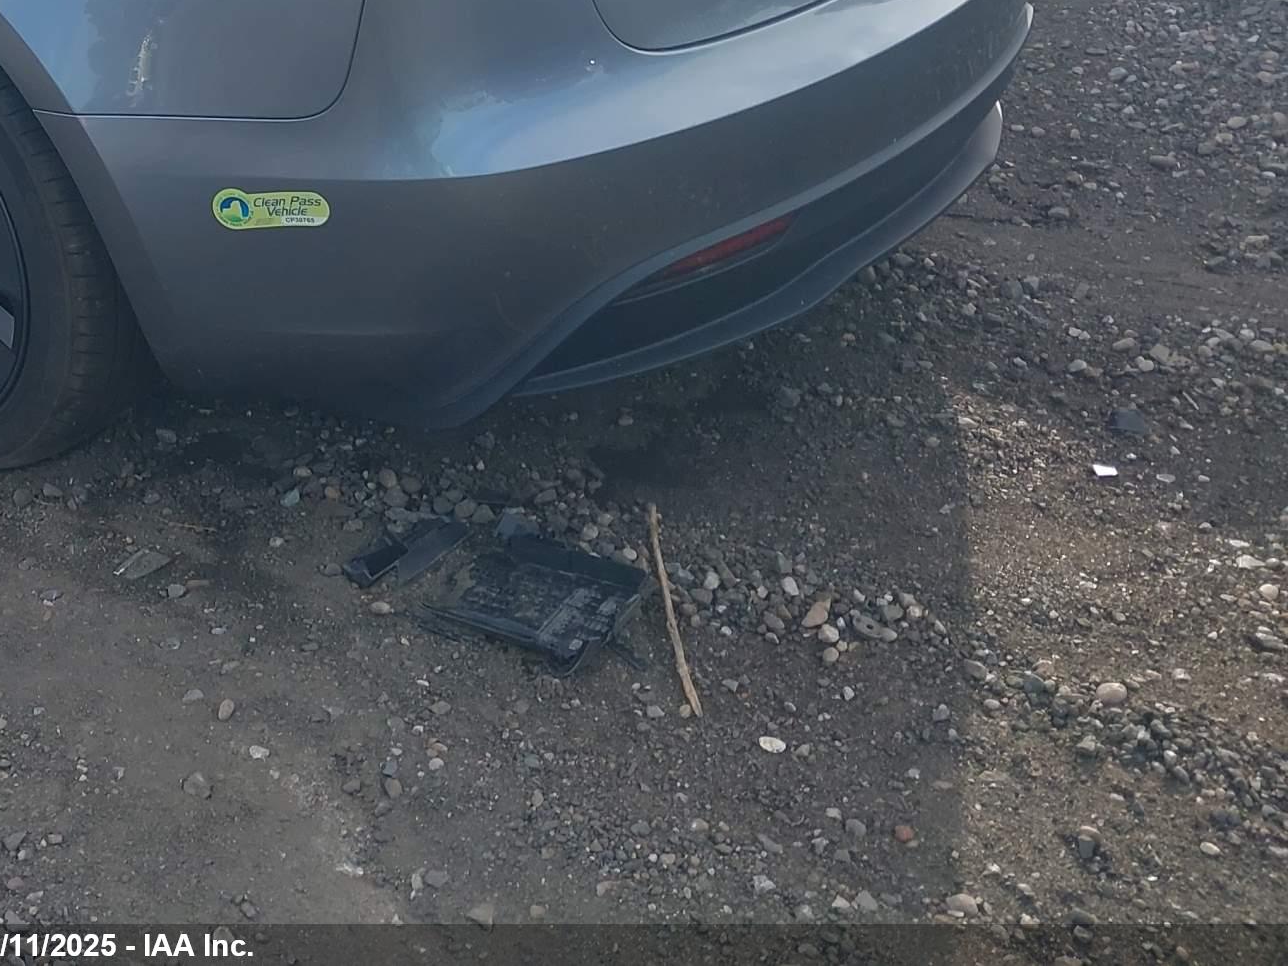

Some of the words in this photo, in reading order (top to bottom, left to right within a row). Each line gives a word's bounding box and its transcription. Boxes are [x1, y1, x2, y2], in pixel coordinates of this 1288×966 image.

[253, 197, 286, 208] Clean
[290, 195, 322, 207] Pass
[267, 206, 308, 217] Vehicle
